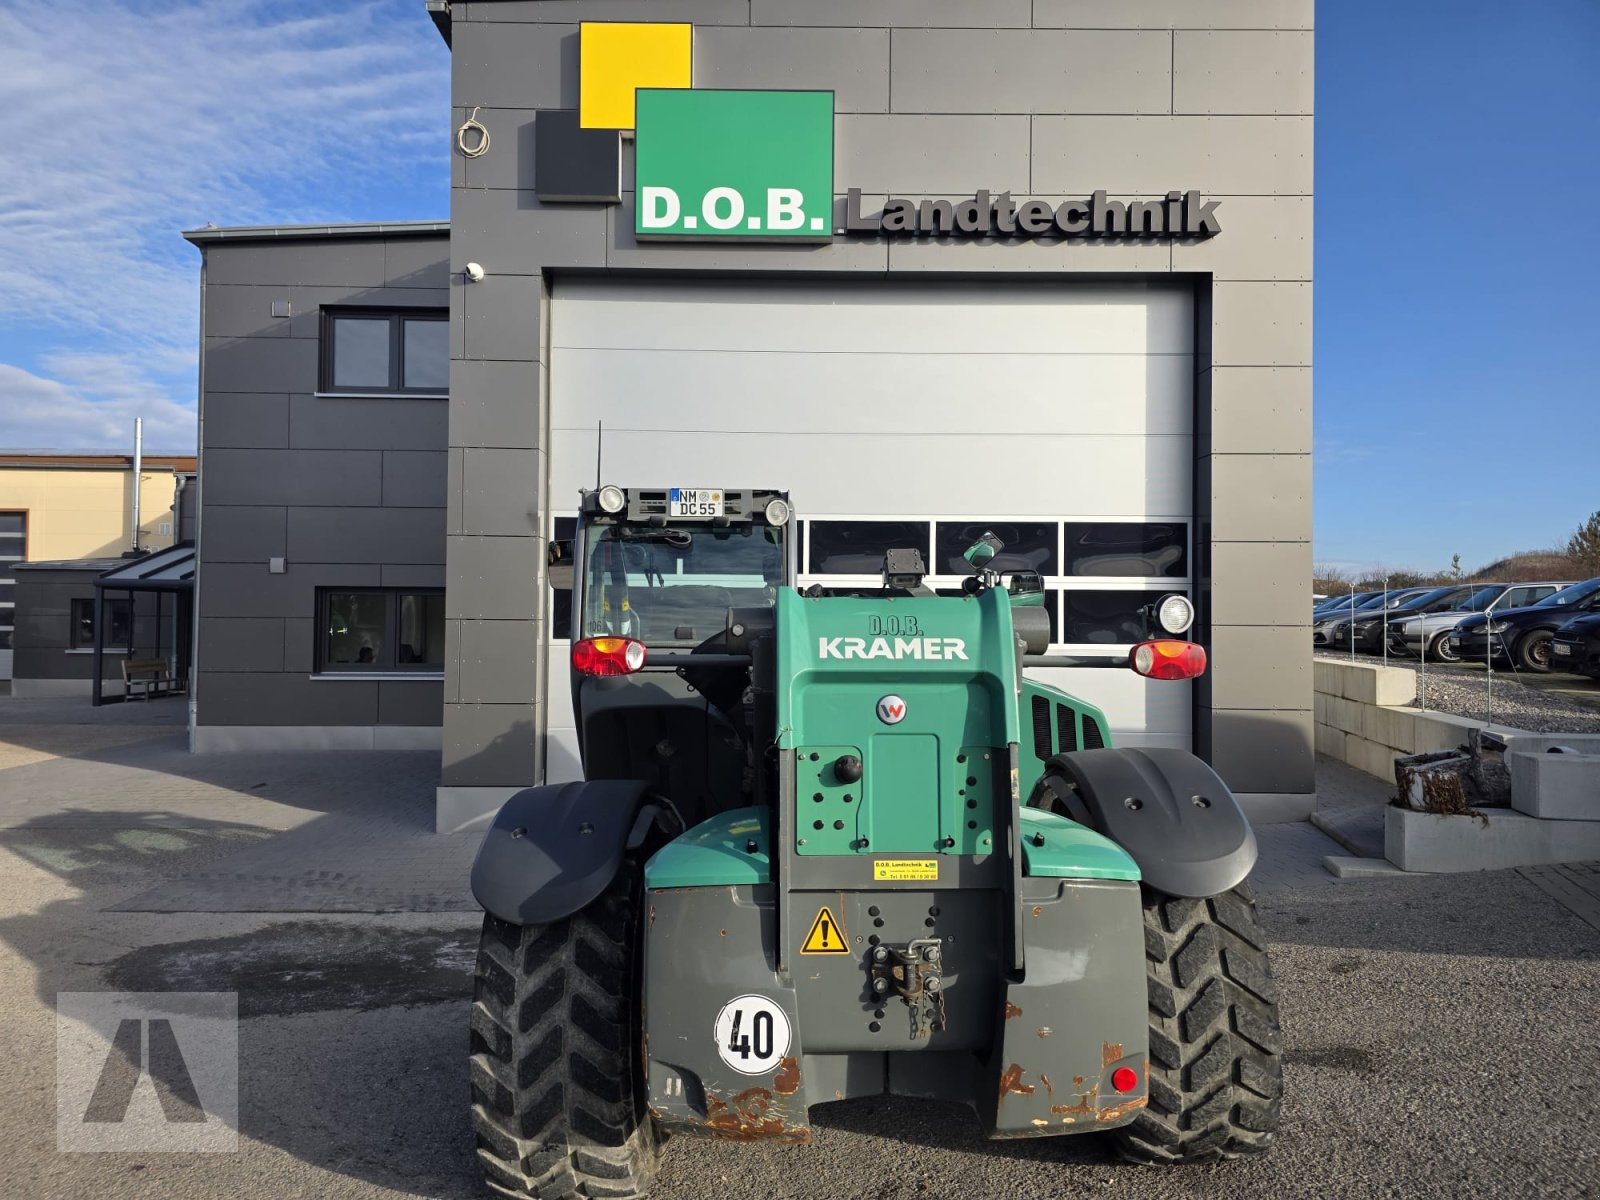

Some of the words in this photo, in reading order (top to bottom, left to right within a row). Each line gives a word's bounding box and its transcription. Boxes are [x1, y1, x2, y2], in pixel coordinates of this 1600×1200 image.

[641, 186, 825, 231] D.O.B.
[846, 188, 1223, 238] Landtechnik
[680, 490, 697, 503] NM
[680, 502, 697, 515] DC
[699, 502, 716, 515] 55
[868, 614, 925, 637] D.O.B.
[818, 636, 969, 660] KRAMER
[727, 1009, 774, 1060] 40
